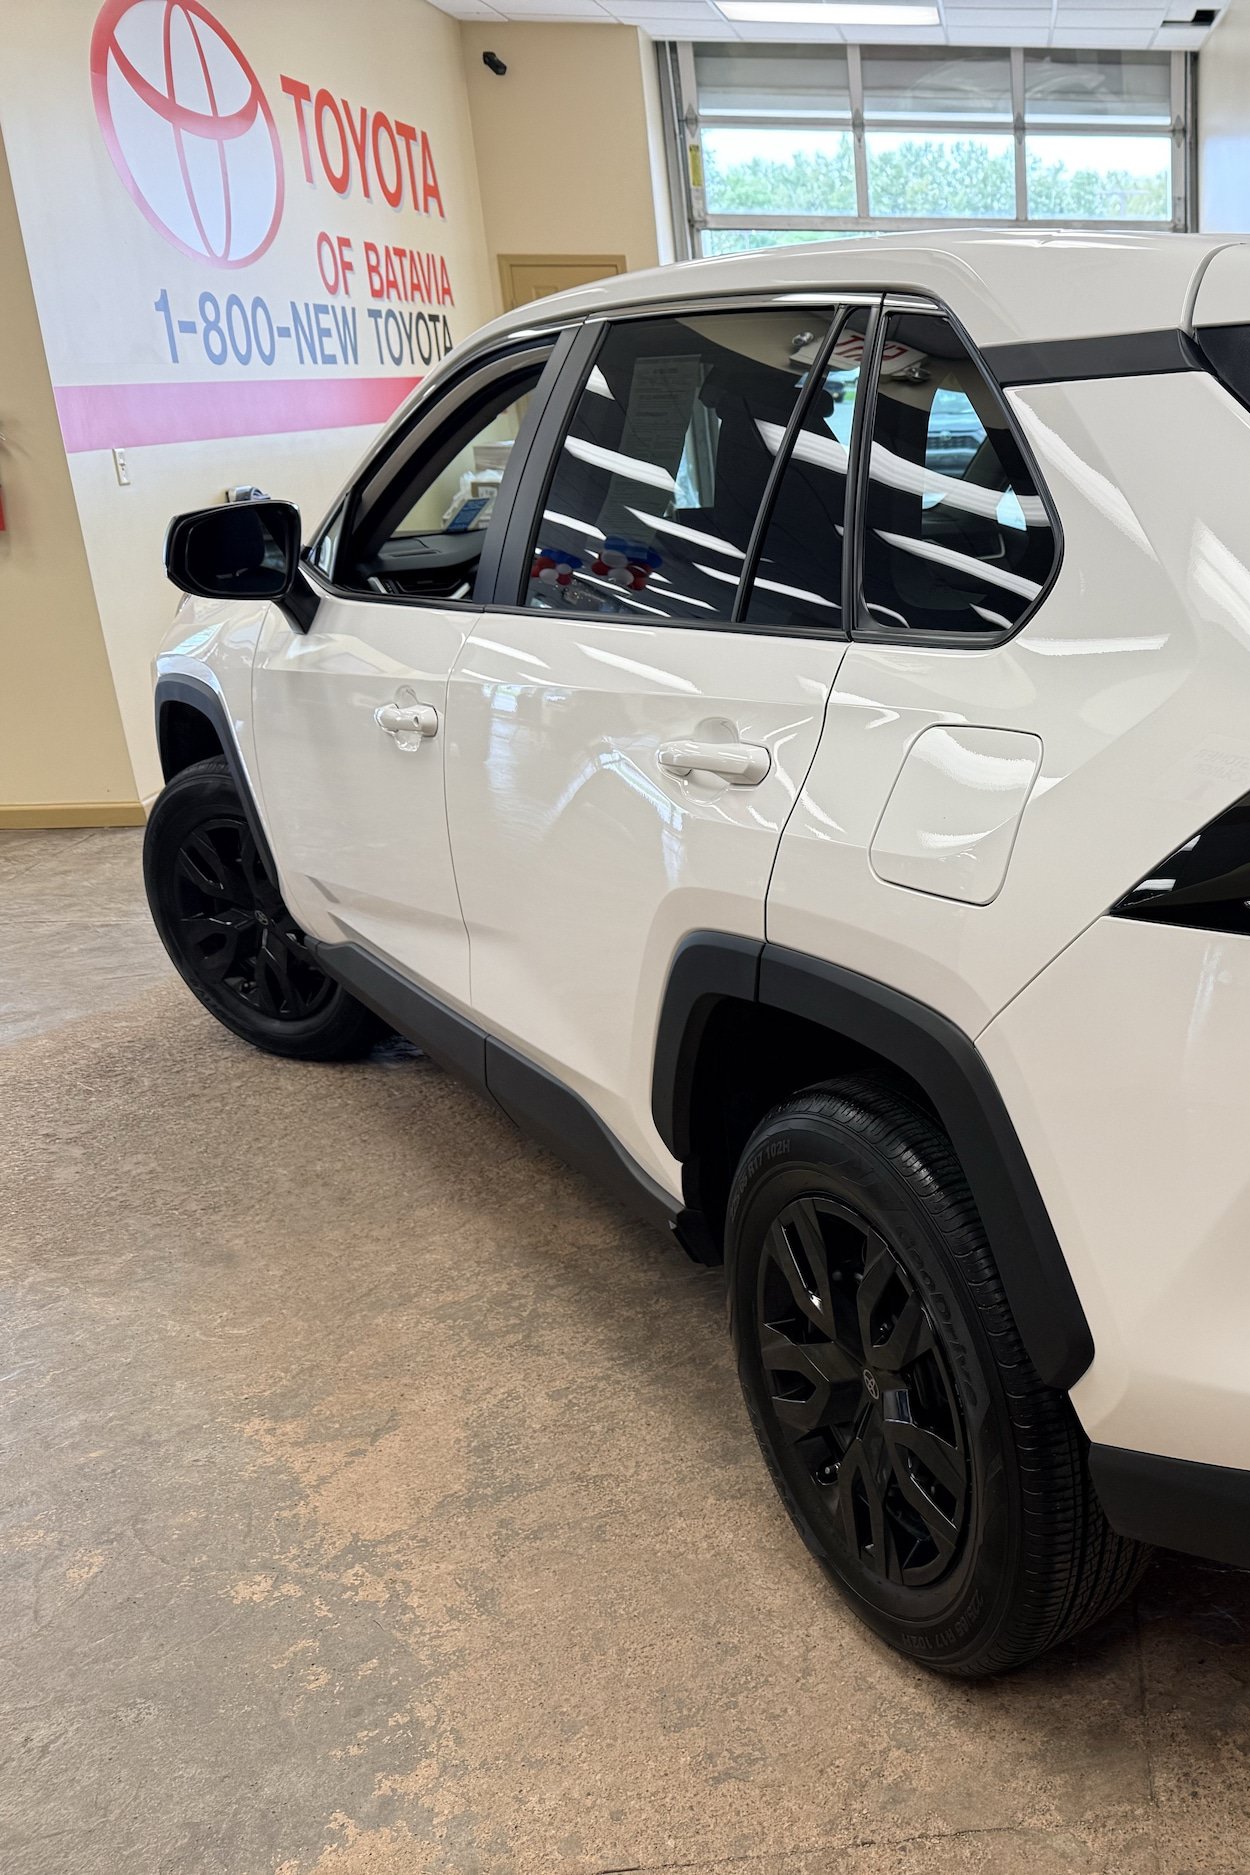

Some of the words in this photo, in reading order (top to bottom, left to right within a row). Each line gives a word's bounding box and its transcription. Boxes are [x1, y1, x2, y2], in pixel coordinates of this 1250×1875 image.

[280, 74, 446, 218] TOYOTA
[317, 231, 354, 296] OF
[364, 241, 456, 307] BATAVIA
[154, 288, 360, 367] 1-800-NEW
[367, 307, 454, 367] TOYOTA
[764, 1138, 791, 1160] 102H
